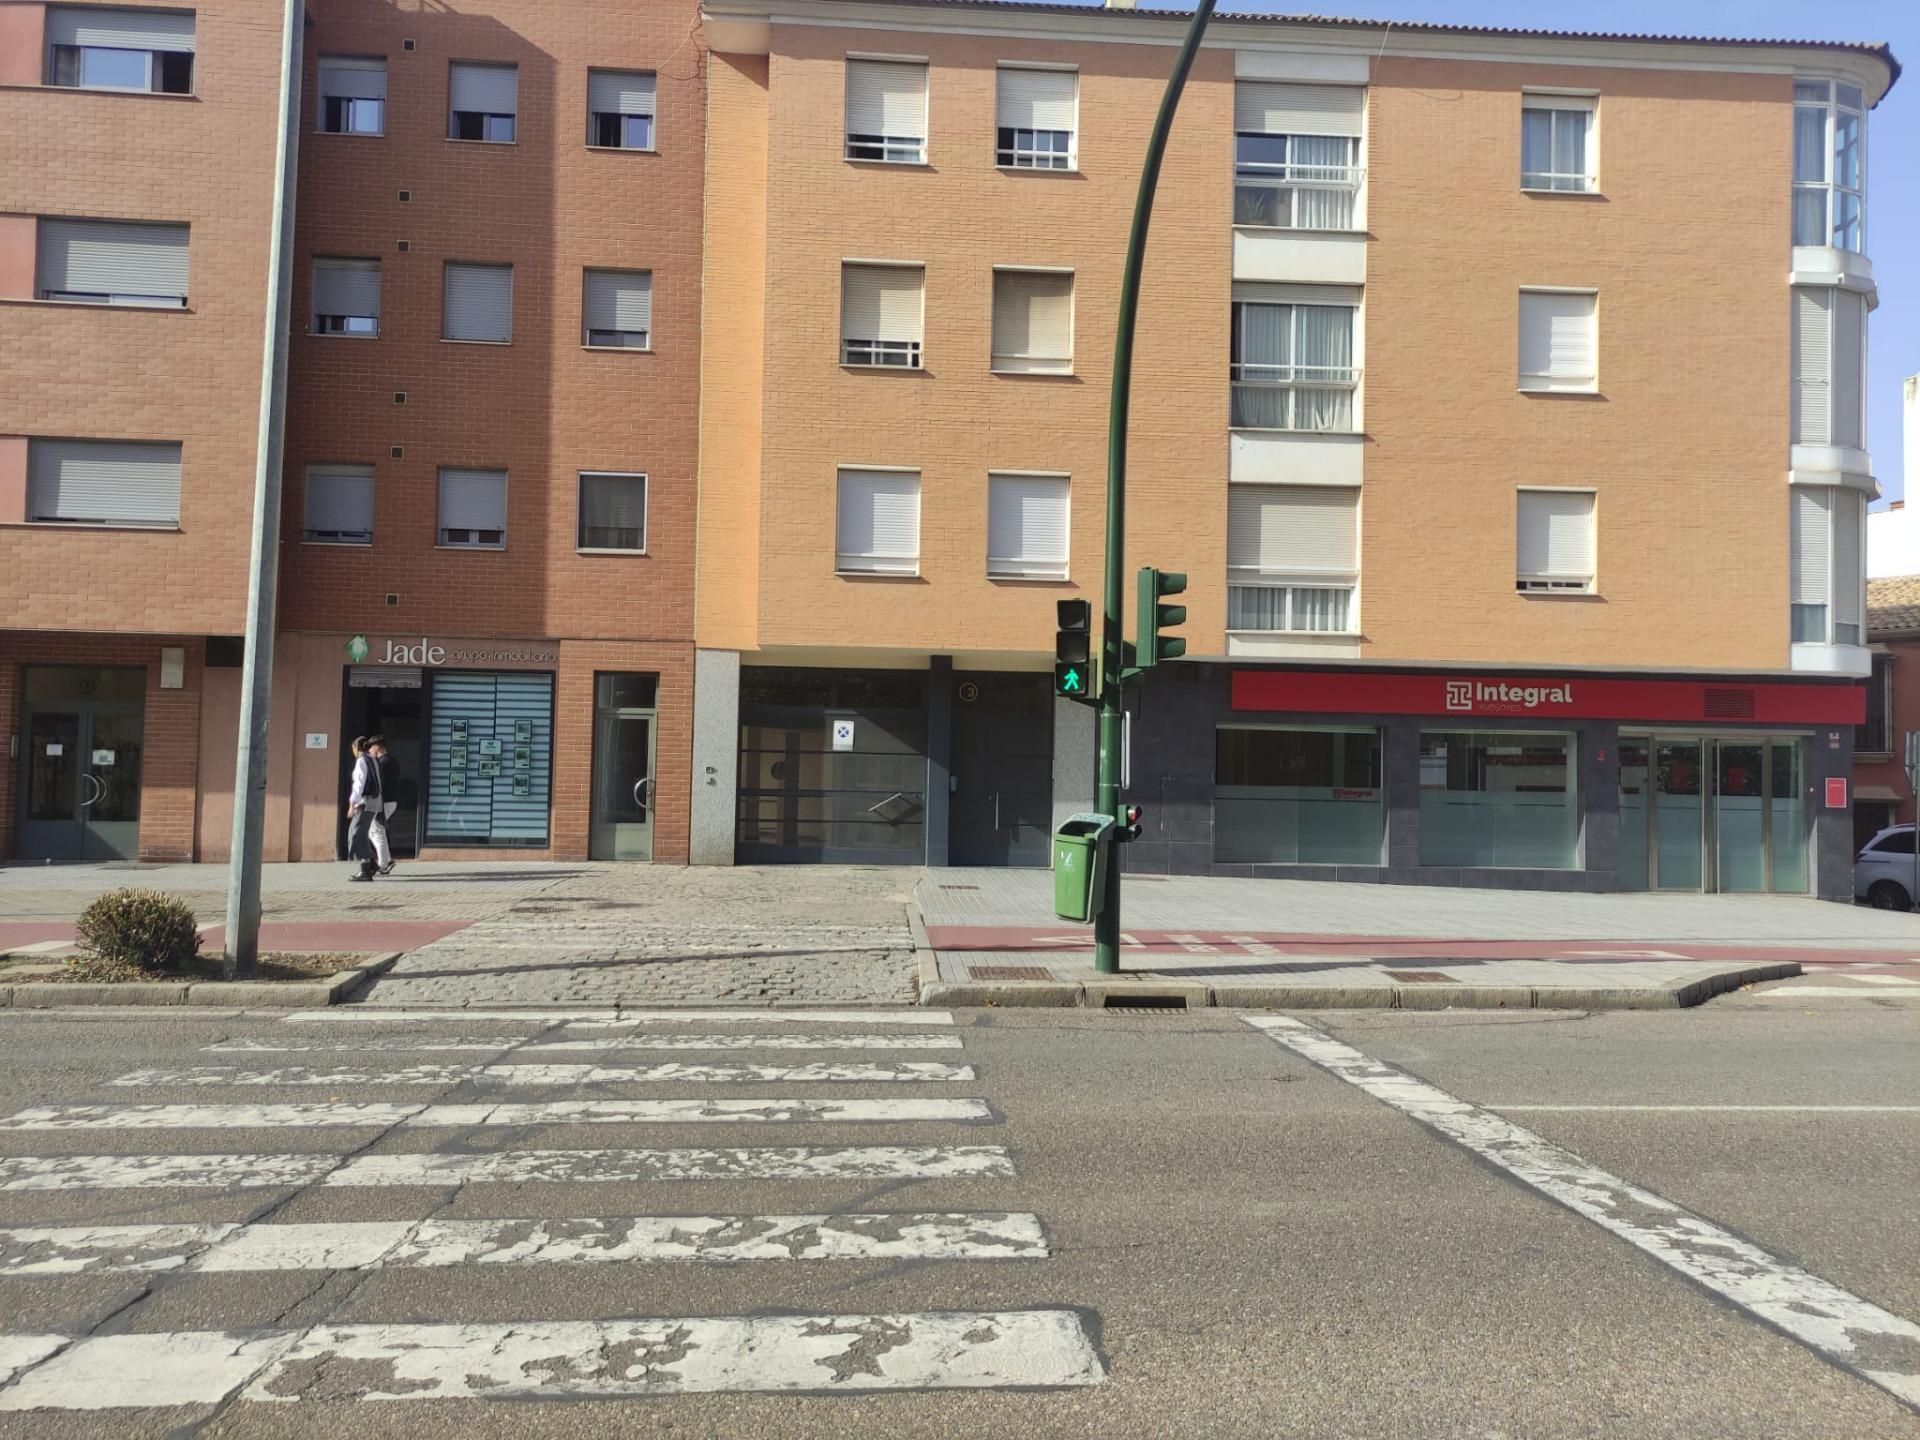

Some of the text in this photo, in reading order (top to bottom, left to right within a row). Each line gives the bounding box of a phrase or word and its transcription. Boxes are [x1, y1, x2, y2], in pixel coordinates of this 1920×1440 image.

[379, 639, 446, 665] Jade
[452, 650, 488, 663] grupo
[1477, 682, 1572, 707] Integral
